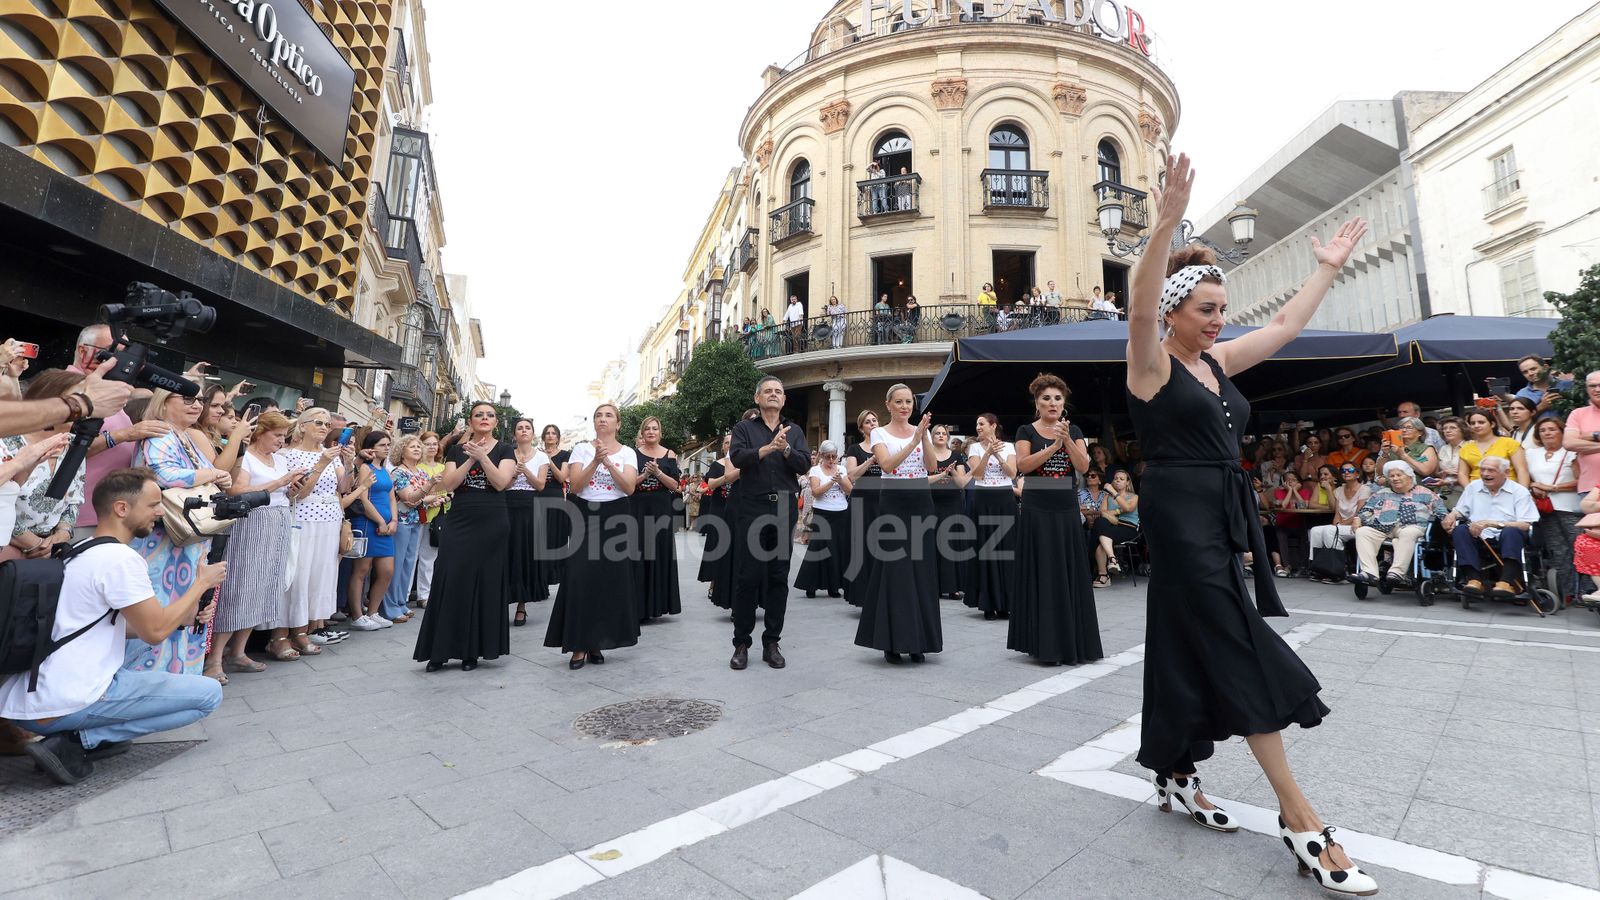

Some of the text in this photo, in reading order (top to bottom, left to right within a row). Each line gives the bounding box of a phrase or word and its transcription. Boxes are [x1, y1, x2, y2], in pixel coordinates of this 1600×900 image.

[199, 0, 234, 34] TICA
[239, 34, 246, 44] Y
[256, 2, 323, 97] Optico
